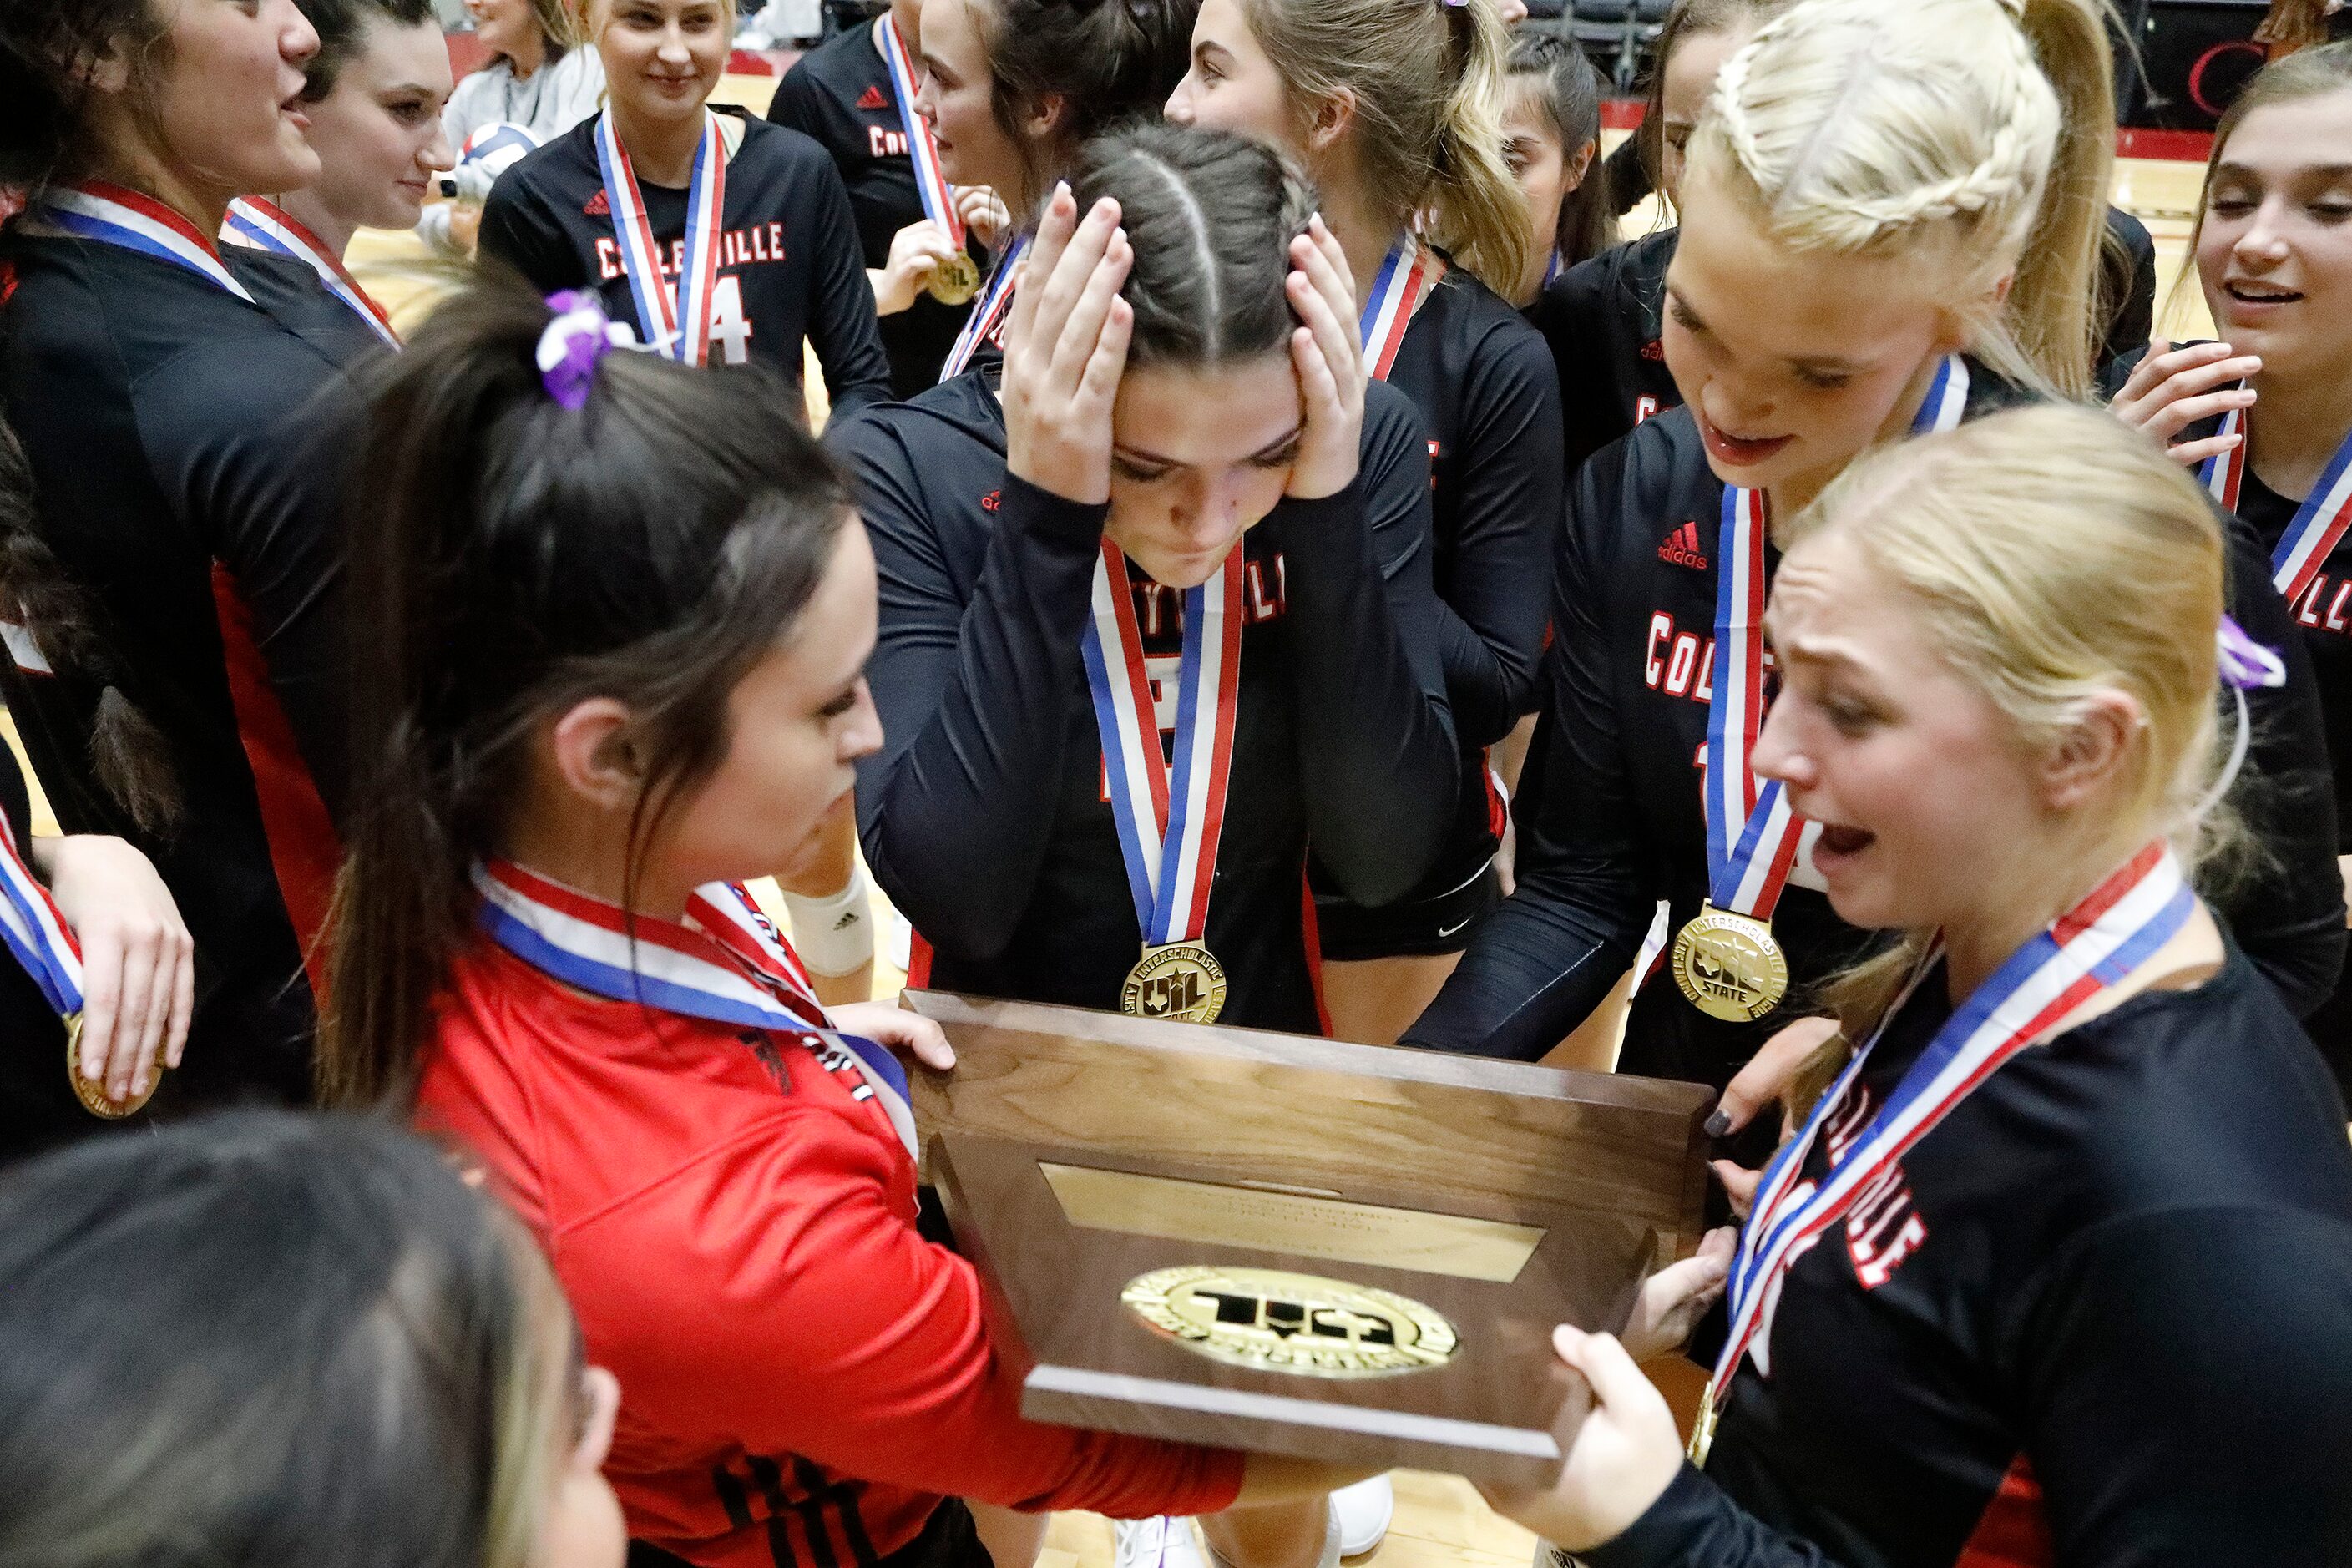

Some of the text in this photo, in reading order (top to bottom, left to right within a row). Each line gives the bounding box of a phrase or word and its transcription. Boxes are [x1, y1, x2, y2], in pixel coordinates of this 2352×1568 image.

[1657, 545, 1709, 571] adidas
[1687, 917, 1784, 972] INTERSCHOLASTIC
[1134, 948, 1224, 982] INTERSCHOLASTIC
[1142, 969, 1206, 1016] UIL
[1702, 980, 1749, 1003] STATE
